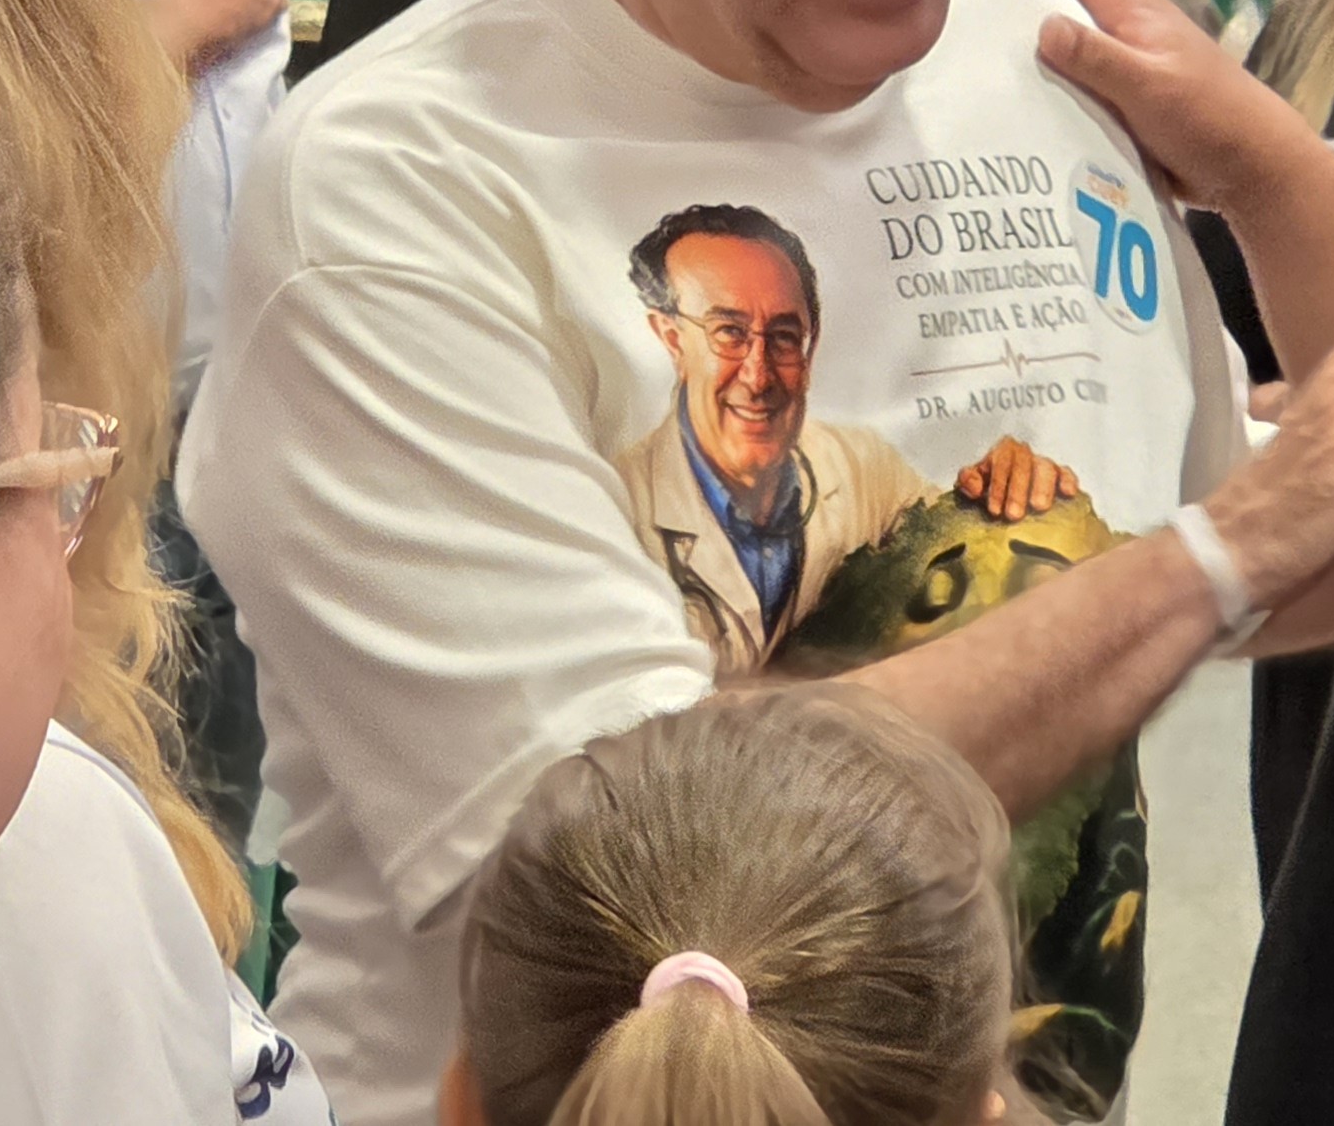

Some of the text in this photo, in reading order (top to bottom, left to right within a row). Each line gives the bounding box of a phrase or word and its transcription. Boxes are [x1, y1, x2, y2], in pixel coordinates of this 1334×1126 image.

[866, 155, 1054, 205] CUIDANDO
[881, 207, 1074, 261] DO BRASIL
[1075, 187, 1159, 323] 70
[896, 259, 1085, 299] COM INTELIGÊNCIA
[919, 304, 1009, 339] EMPATIA
[1013, 303, 1028, 329] E
[1030, 296, 1089, 332] AÇÃO
[916, 397, 958, 420] DR.
[968, 382, 1066, 415] AUGUSTO
